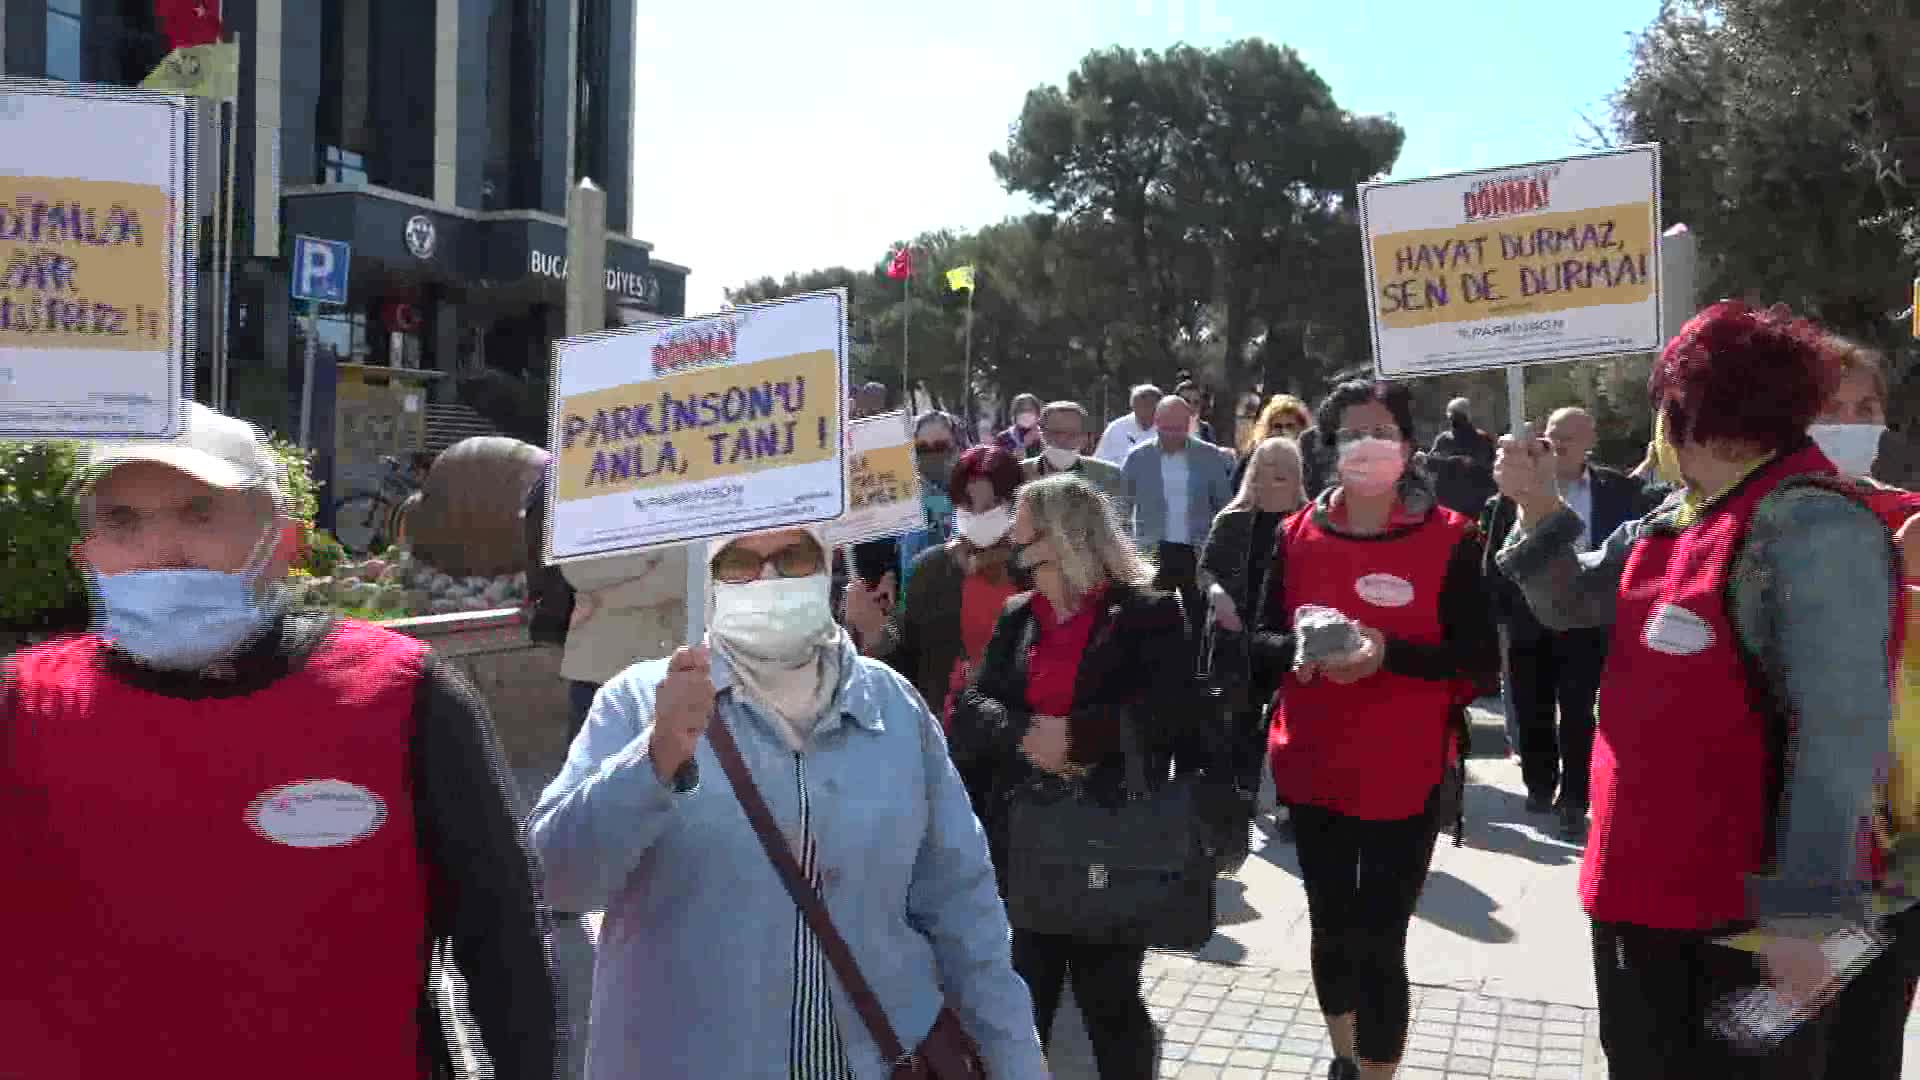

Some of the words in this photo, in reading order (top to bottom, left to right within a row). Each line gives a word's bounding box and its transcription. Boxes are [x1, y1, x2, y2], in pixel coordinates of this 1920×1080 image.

[302, 241, 334, 294] P
[1396, 236, 1487, 272] HAYAT
[1500, 220, 1624, 260] DURMAZ,
[1382, 276, 1450, 314] SEN
[1460, 270, 1507, 303] DE
[1520, 254, 1647, 297] DURMA!
[585, 441, 688, 488] ANLA,
